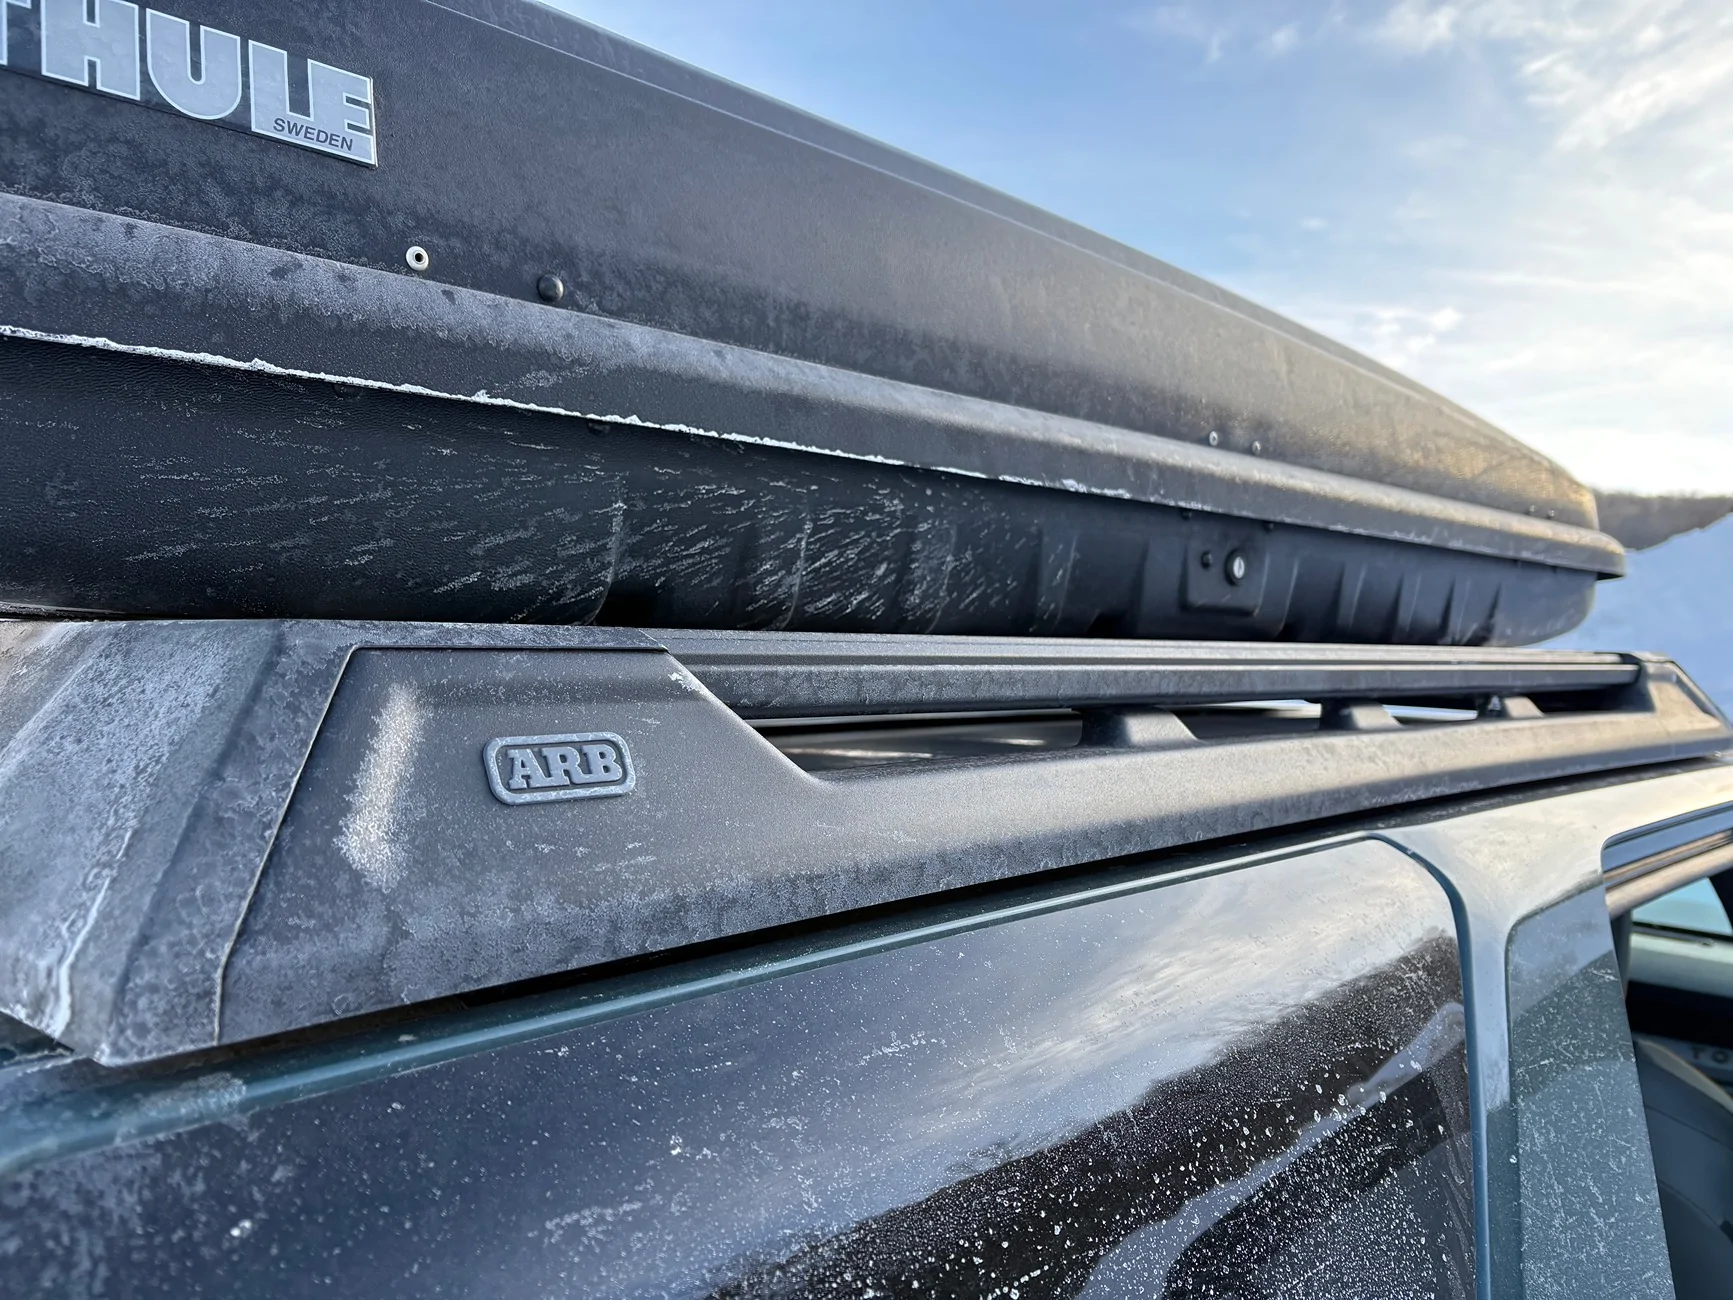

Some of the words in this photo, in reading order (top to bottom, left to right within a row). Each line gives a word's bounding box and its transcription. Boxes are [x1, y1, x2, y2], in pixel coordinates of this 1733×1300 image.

[0, 0, 376, 165] HULE
[273, 117, 353, 151] SWEDEN
[507, 744, 623, 789] ARB
